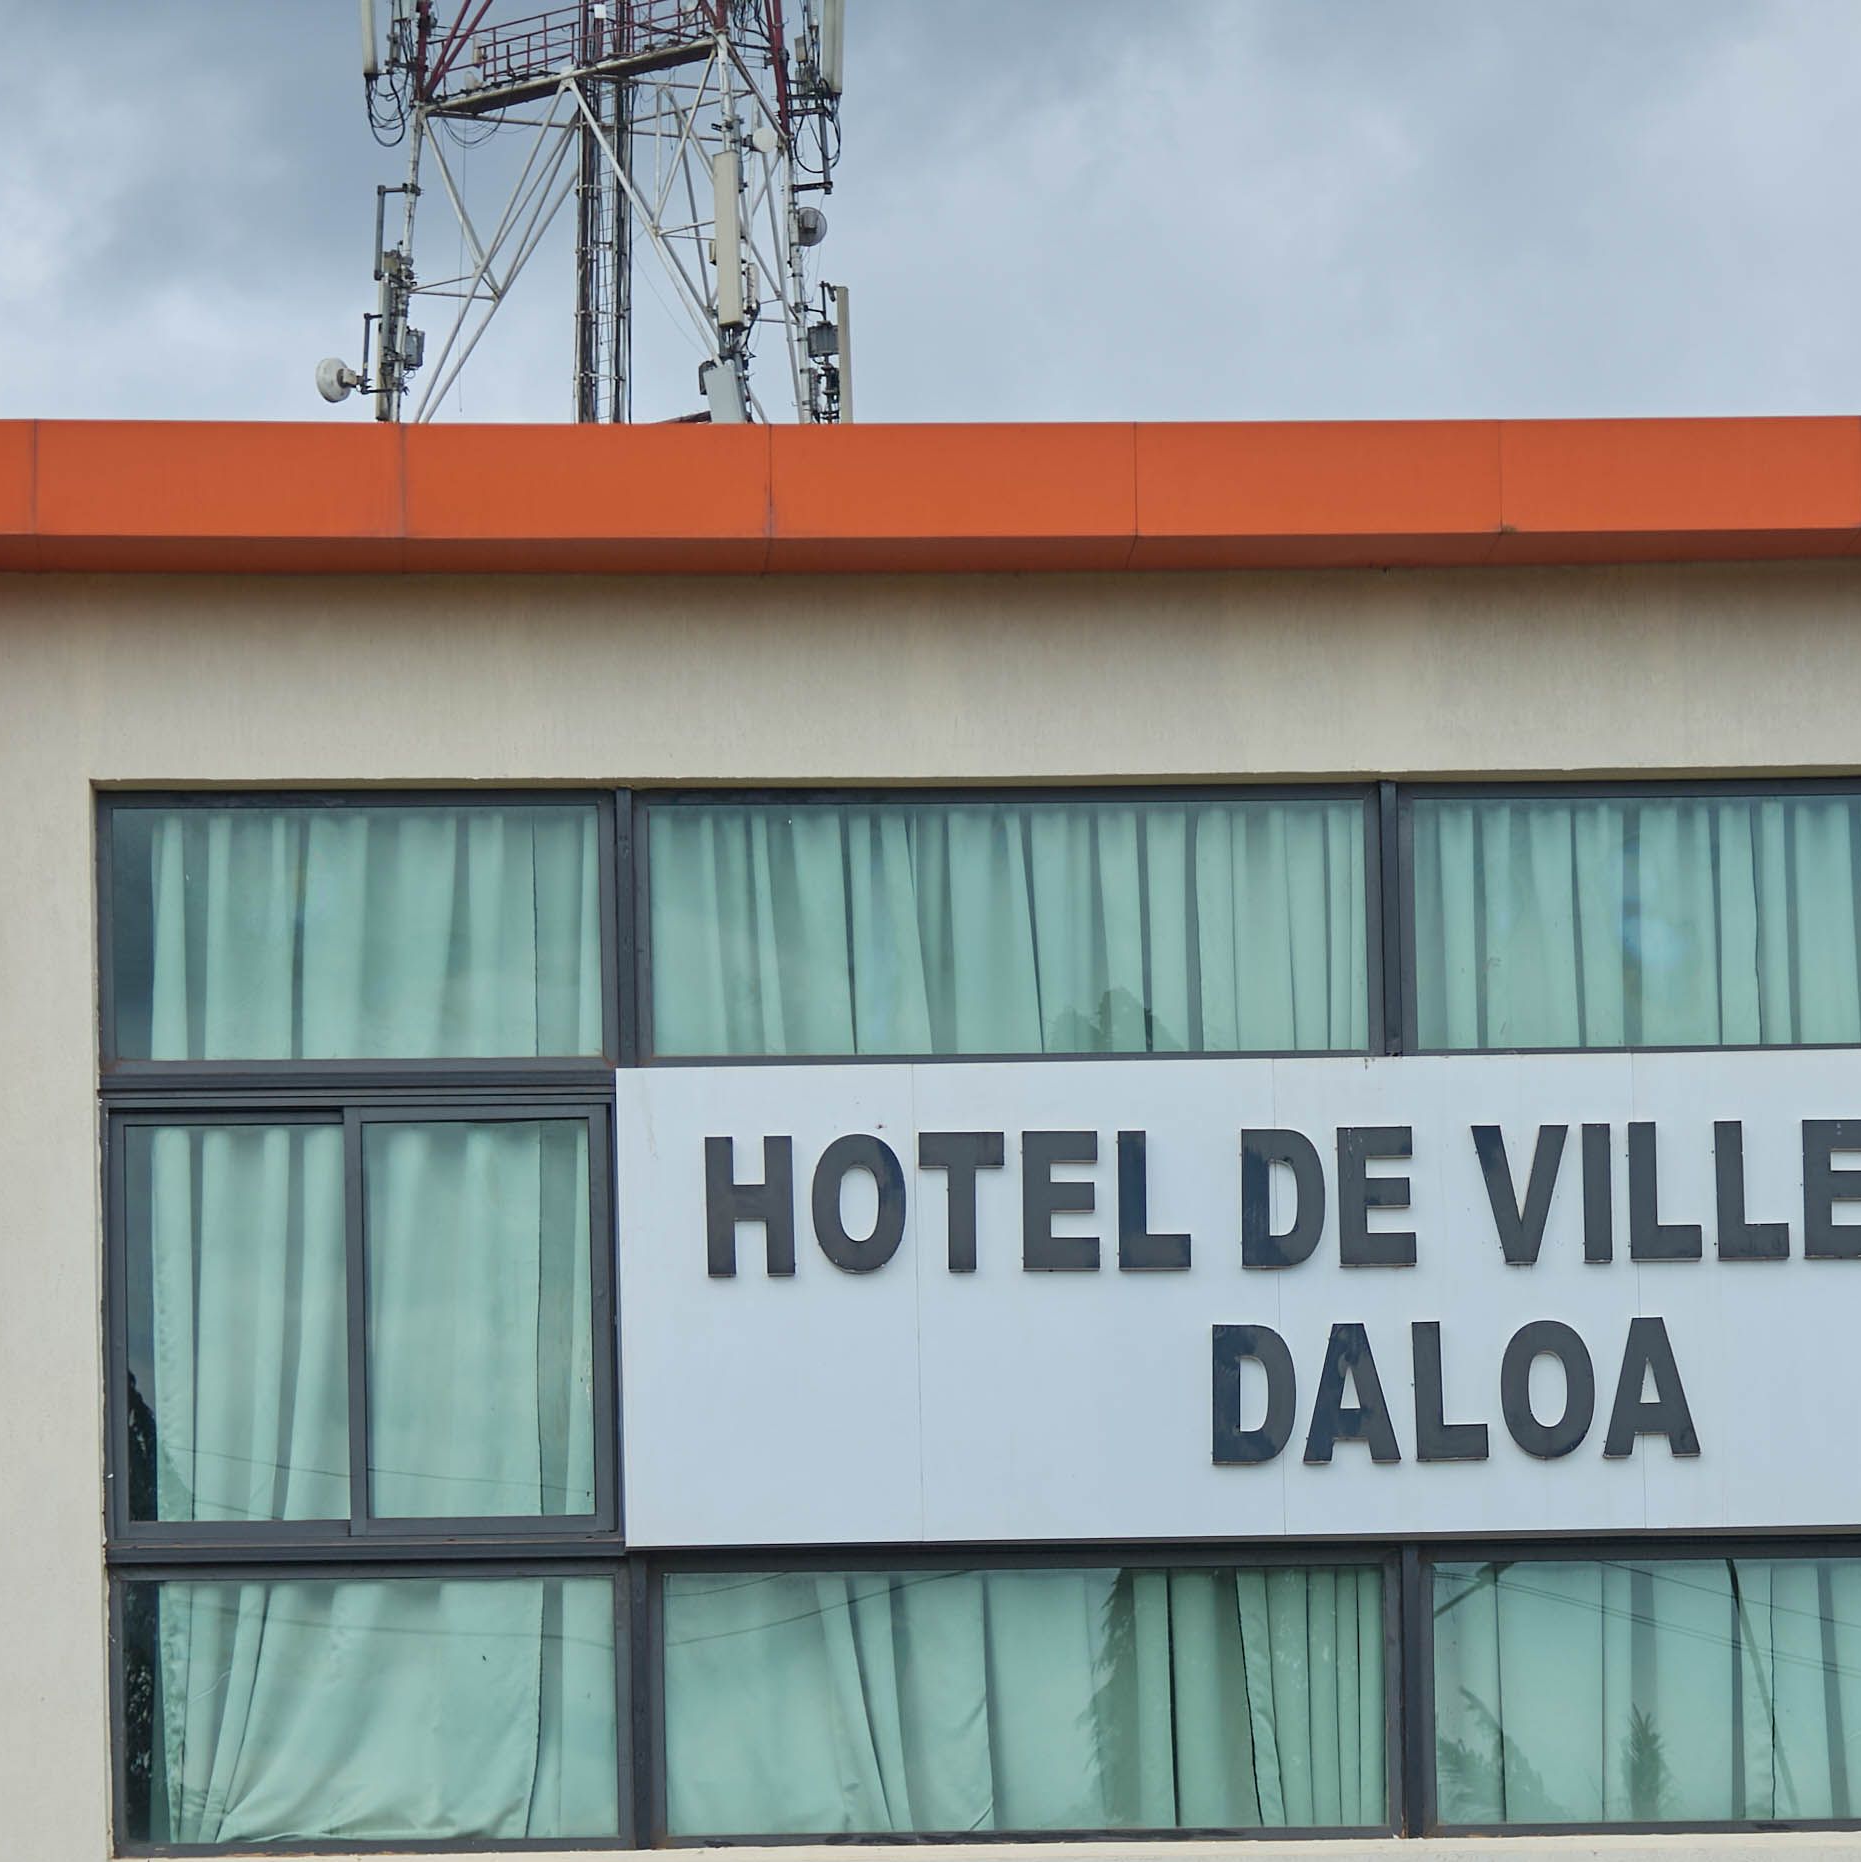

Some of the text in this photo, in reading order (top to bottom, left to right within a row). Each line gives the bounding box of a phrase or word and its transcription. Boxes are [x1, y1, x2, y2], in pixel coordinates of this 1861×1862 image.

[703, 1129, 1193, 1279] HOTEL
[1240, 1125, 1418, 1272] DE
[1210, 1316, 1703, 1468] DALOA
